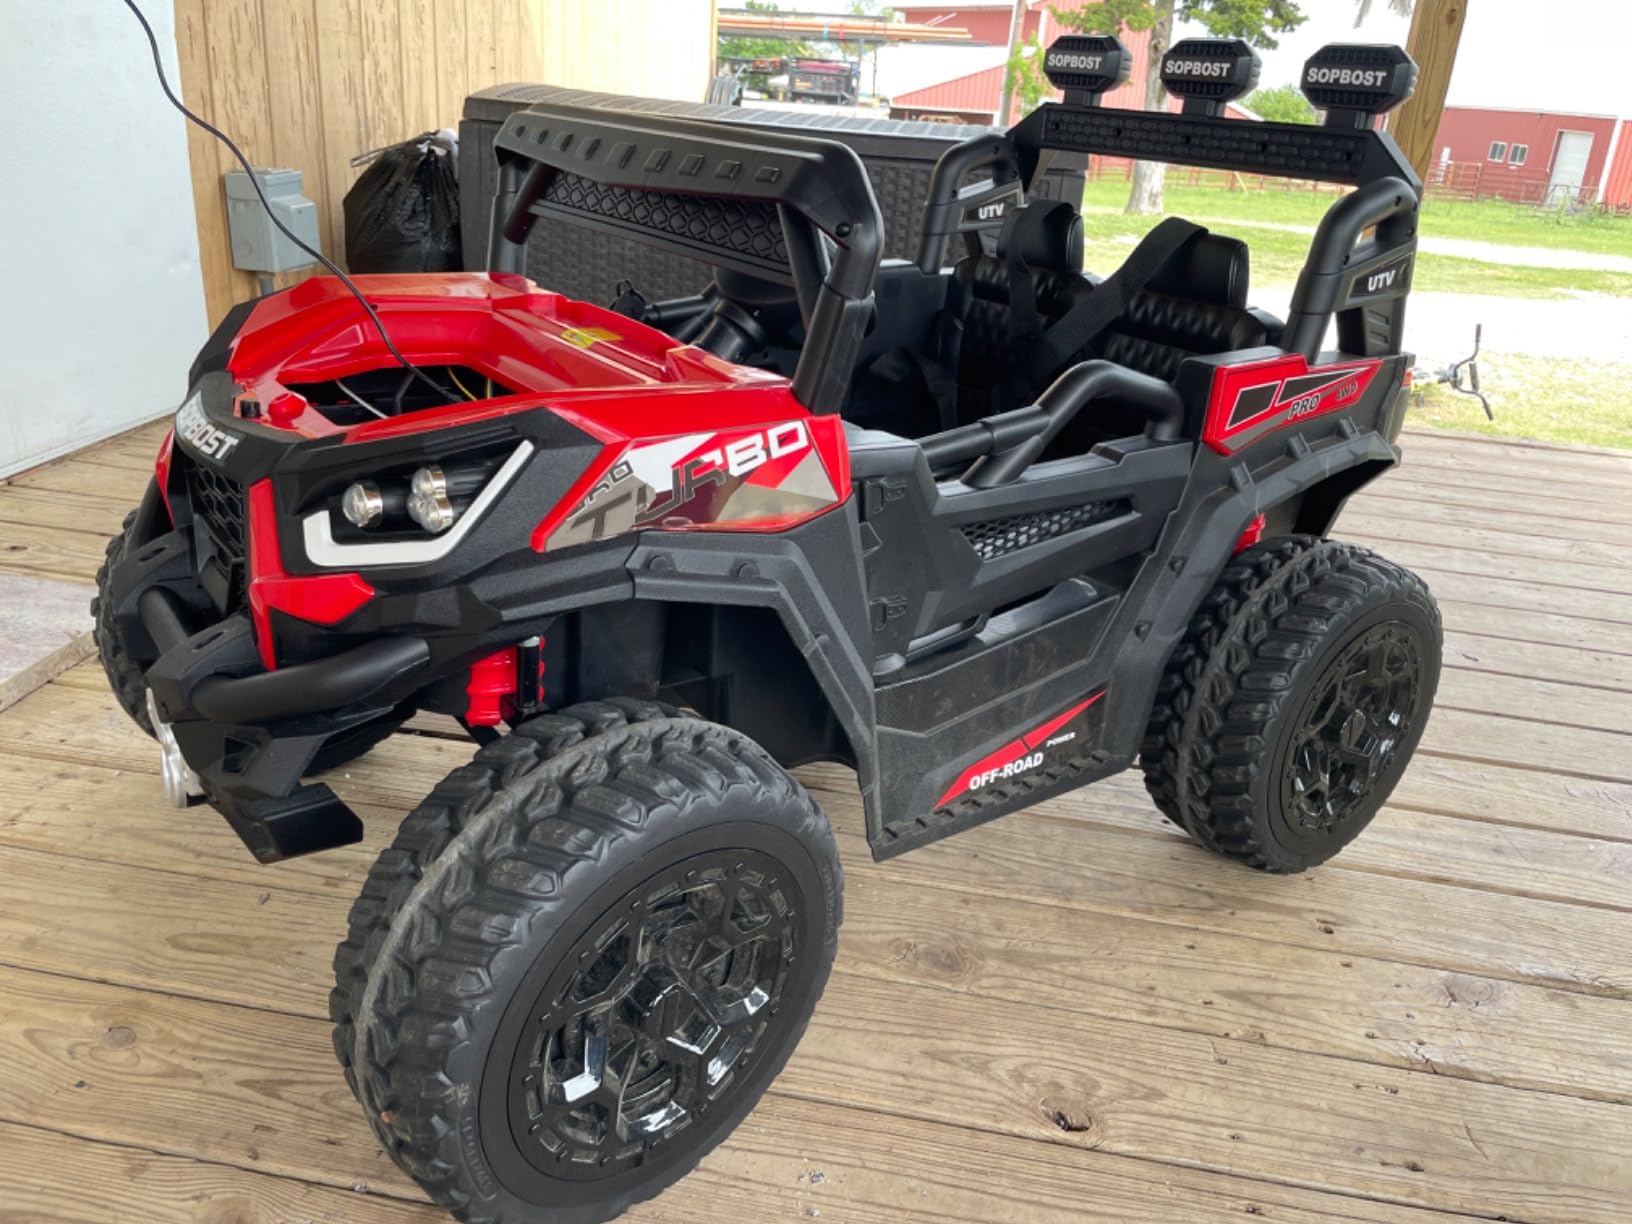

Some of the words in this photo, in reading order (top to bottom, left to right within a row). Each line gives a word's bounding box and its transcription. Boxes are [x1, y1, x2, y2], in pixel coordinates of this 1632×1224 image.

[1047, 54, 1102, 70] SOPBOST
[1164, 59, 1230, 77] SOPBOST
[1307, 67, 1387, 86] SOPBOST
[978, 202, 1005, 219] UTV
[1368, 269, 1396, 292] UTV
[1288, 392, 1321, 420] PRO
[568, 420, 809, 541] TURBO
[969, 752, 1044, 790] OFF-ROAD
